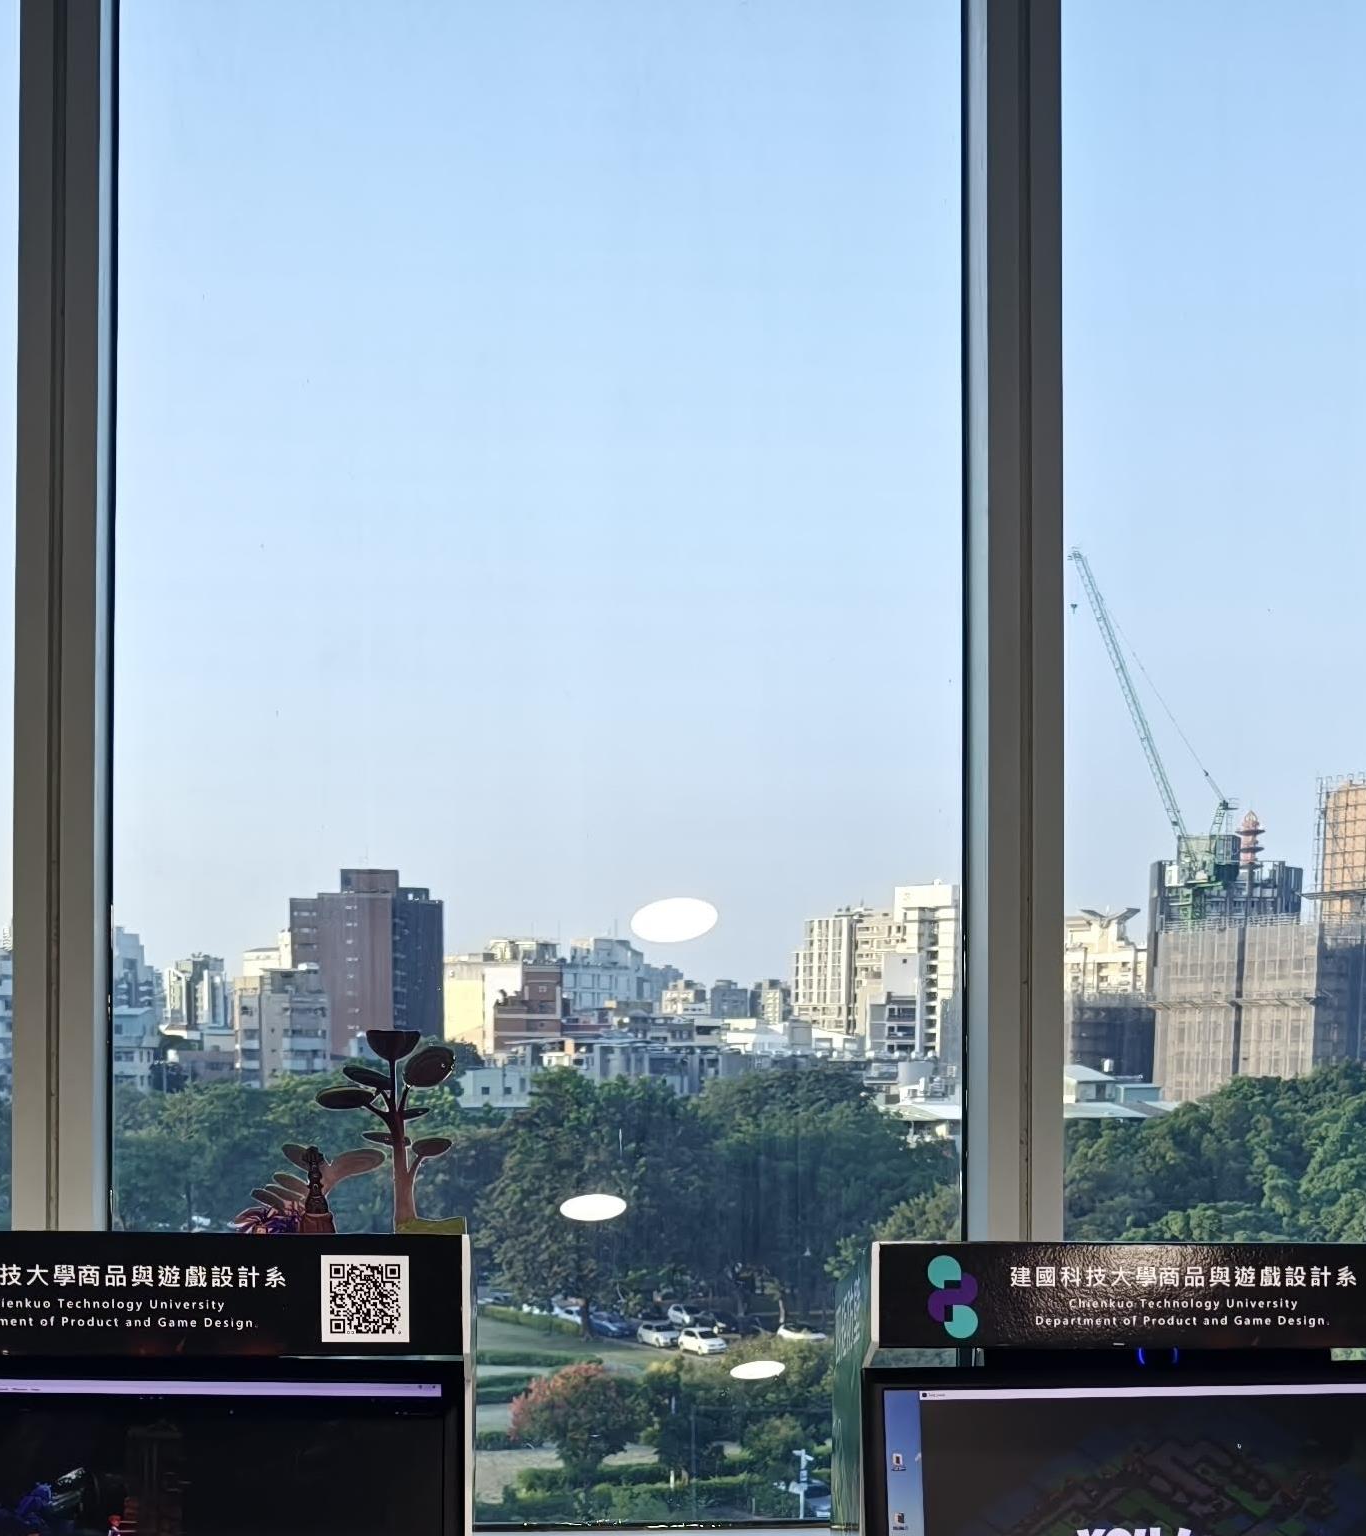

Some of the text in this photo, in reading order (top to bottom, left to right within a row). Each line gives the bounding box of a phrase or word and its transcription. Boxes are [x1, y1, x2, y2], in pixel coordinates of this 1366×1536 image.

[1010, 1265, 1357, 1288] 建國科技大學商品與遊戲設計系
[57, 1298, 143, 1312] Technology
[149, 1299, 225, 1313] University
[1069, 1298, 1298, 1311] Chienkuo Technology University
[40, 1315, 55, 1327] of
[61, 1316, 119, 1328] Product
[125, 1316, 151, 1328] and
[157, 1317, 197, 1328] Game
[1035, 1315, 1118, 1328] Department
[1123, 1315, 1138, 1326] of
[1143, 1315, 1197, 1326] Product
[1203, 1315, 1228, 1326] and
[1233, 1315, 1272, 1326] Game
